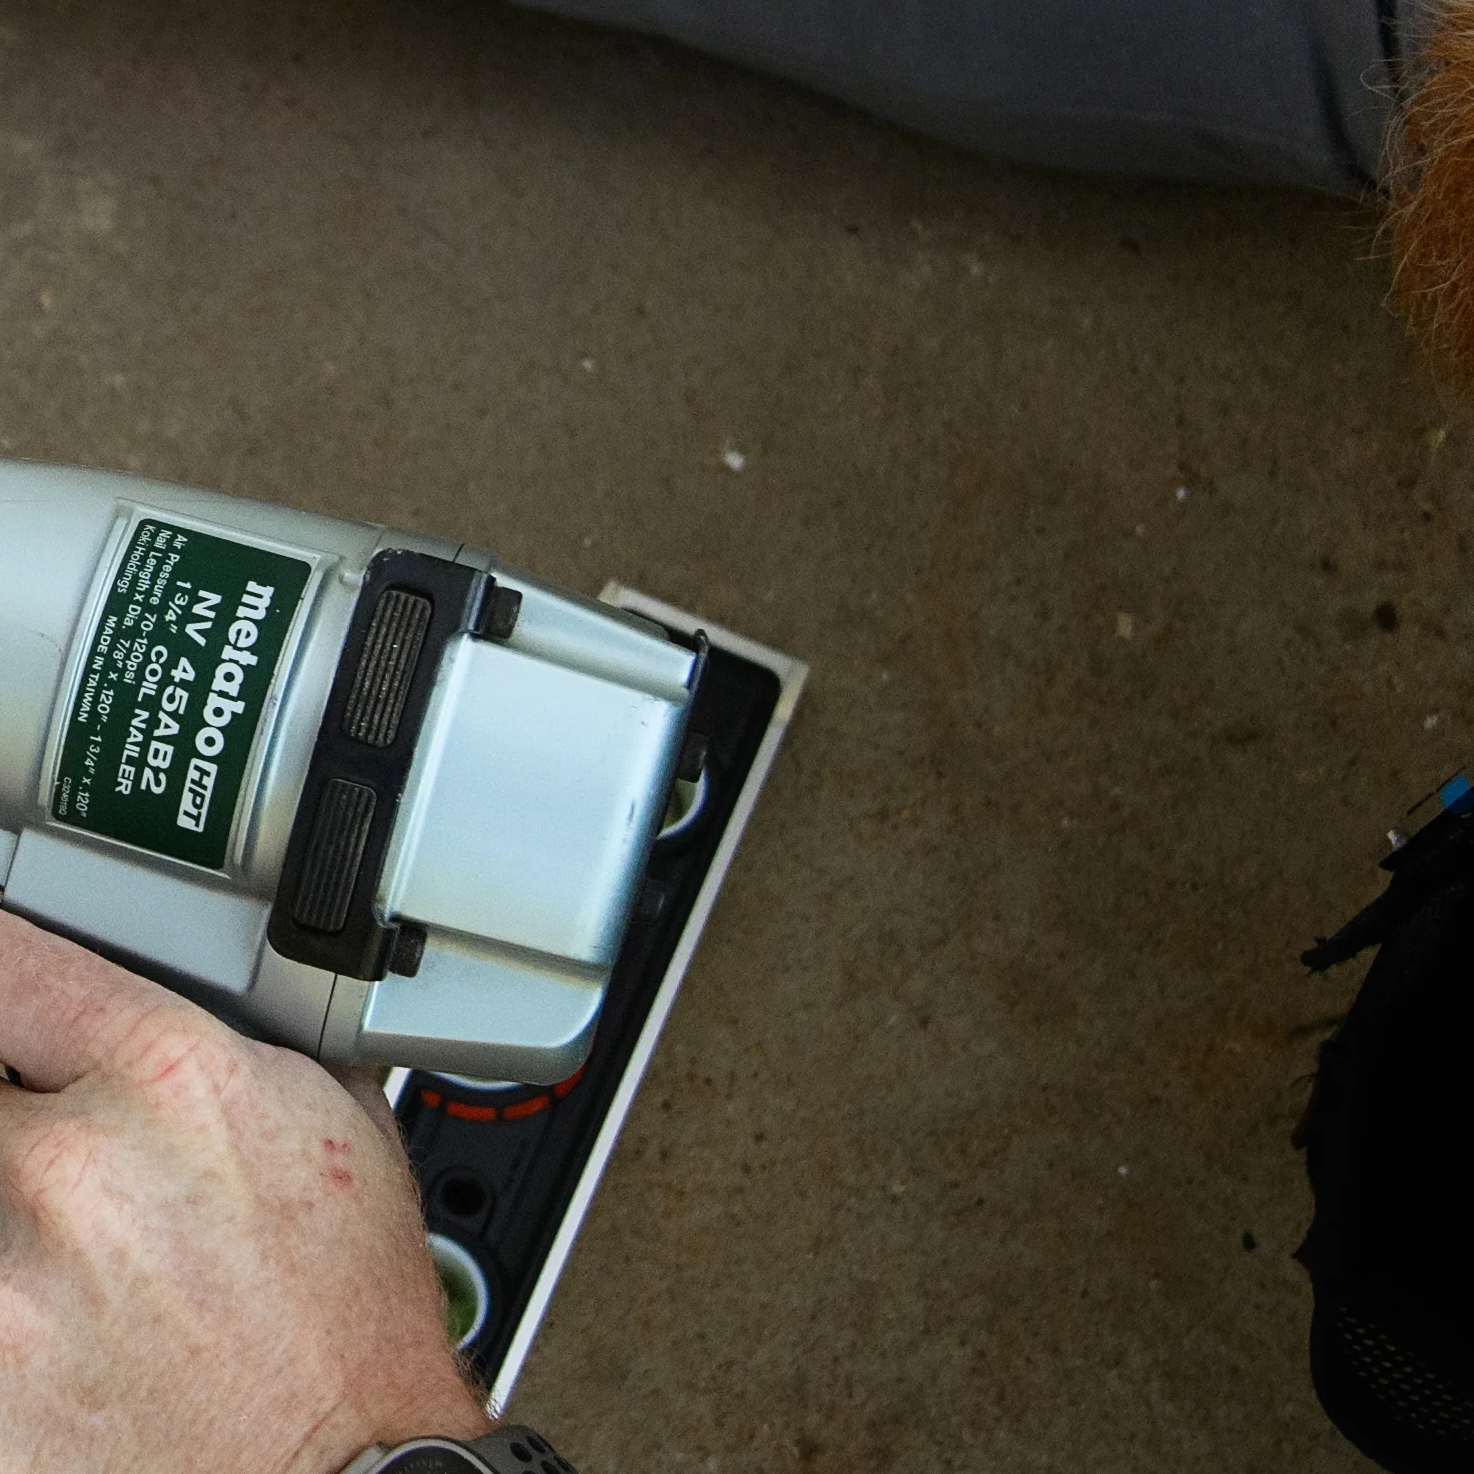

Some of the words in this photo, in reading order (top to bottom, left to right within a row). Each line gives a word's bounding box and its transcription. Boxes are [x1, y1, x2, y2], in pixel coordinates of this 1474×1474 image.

[136, 524, 156, 546] Koki
[153, 529, 172, 550] Nail
[172, 533, 188, 550] Air
[117, 545, 146, 593] Holdings
[136, 551, 162, 591] Length
[149, 552, 181, 605] Pressure
[97, 615, 118, 655] MADE
[122, 604, 141, 629] Dia.
[184, 589, 222, 647] NV
[92, 655, 104, 670] IN
[123, 612, 157, 684] 70-120psi
[195, 580, 275, 757] metabo
[77, 673, 100, 723] TAIWAN
[137, 645, 168, 702] COIL
[140, 656, 196, 795] 45AB2
[114, 708, 150, 795] NAILER
[180, 761, 216, 830] HPT
